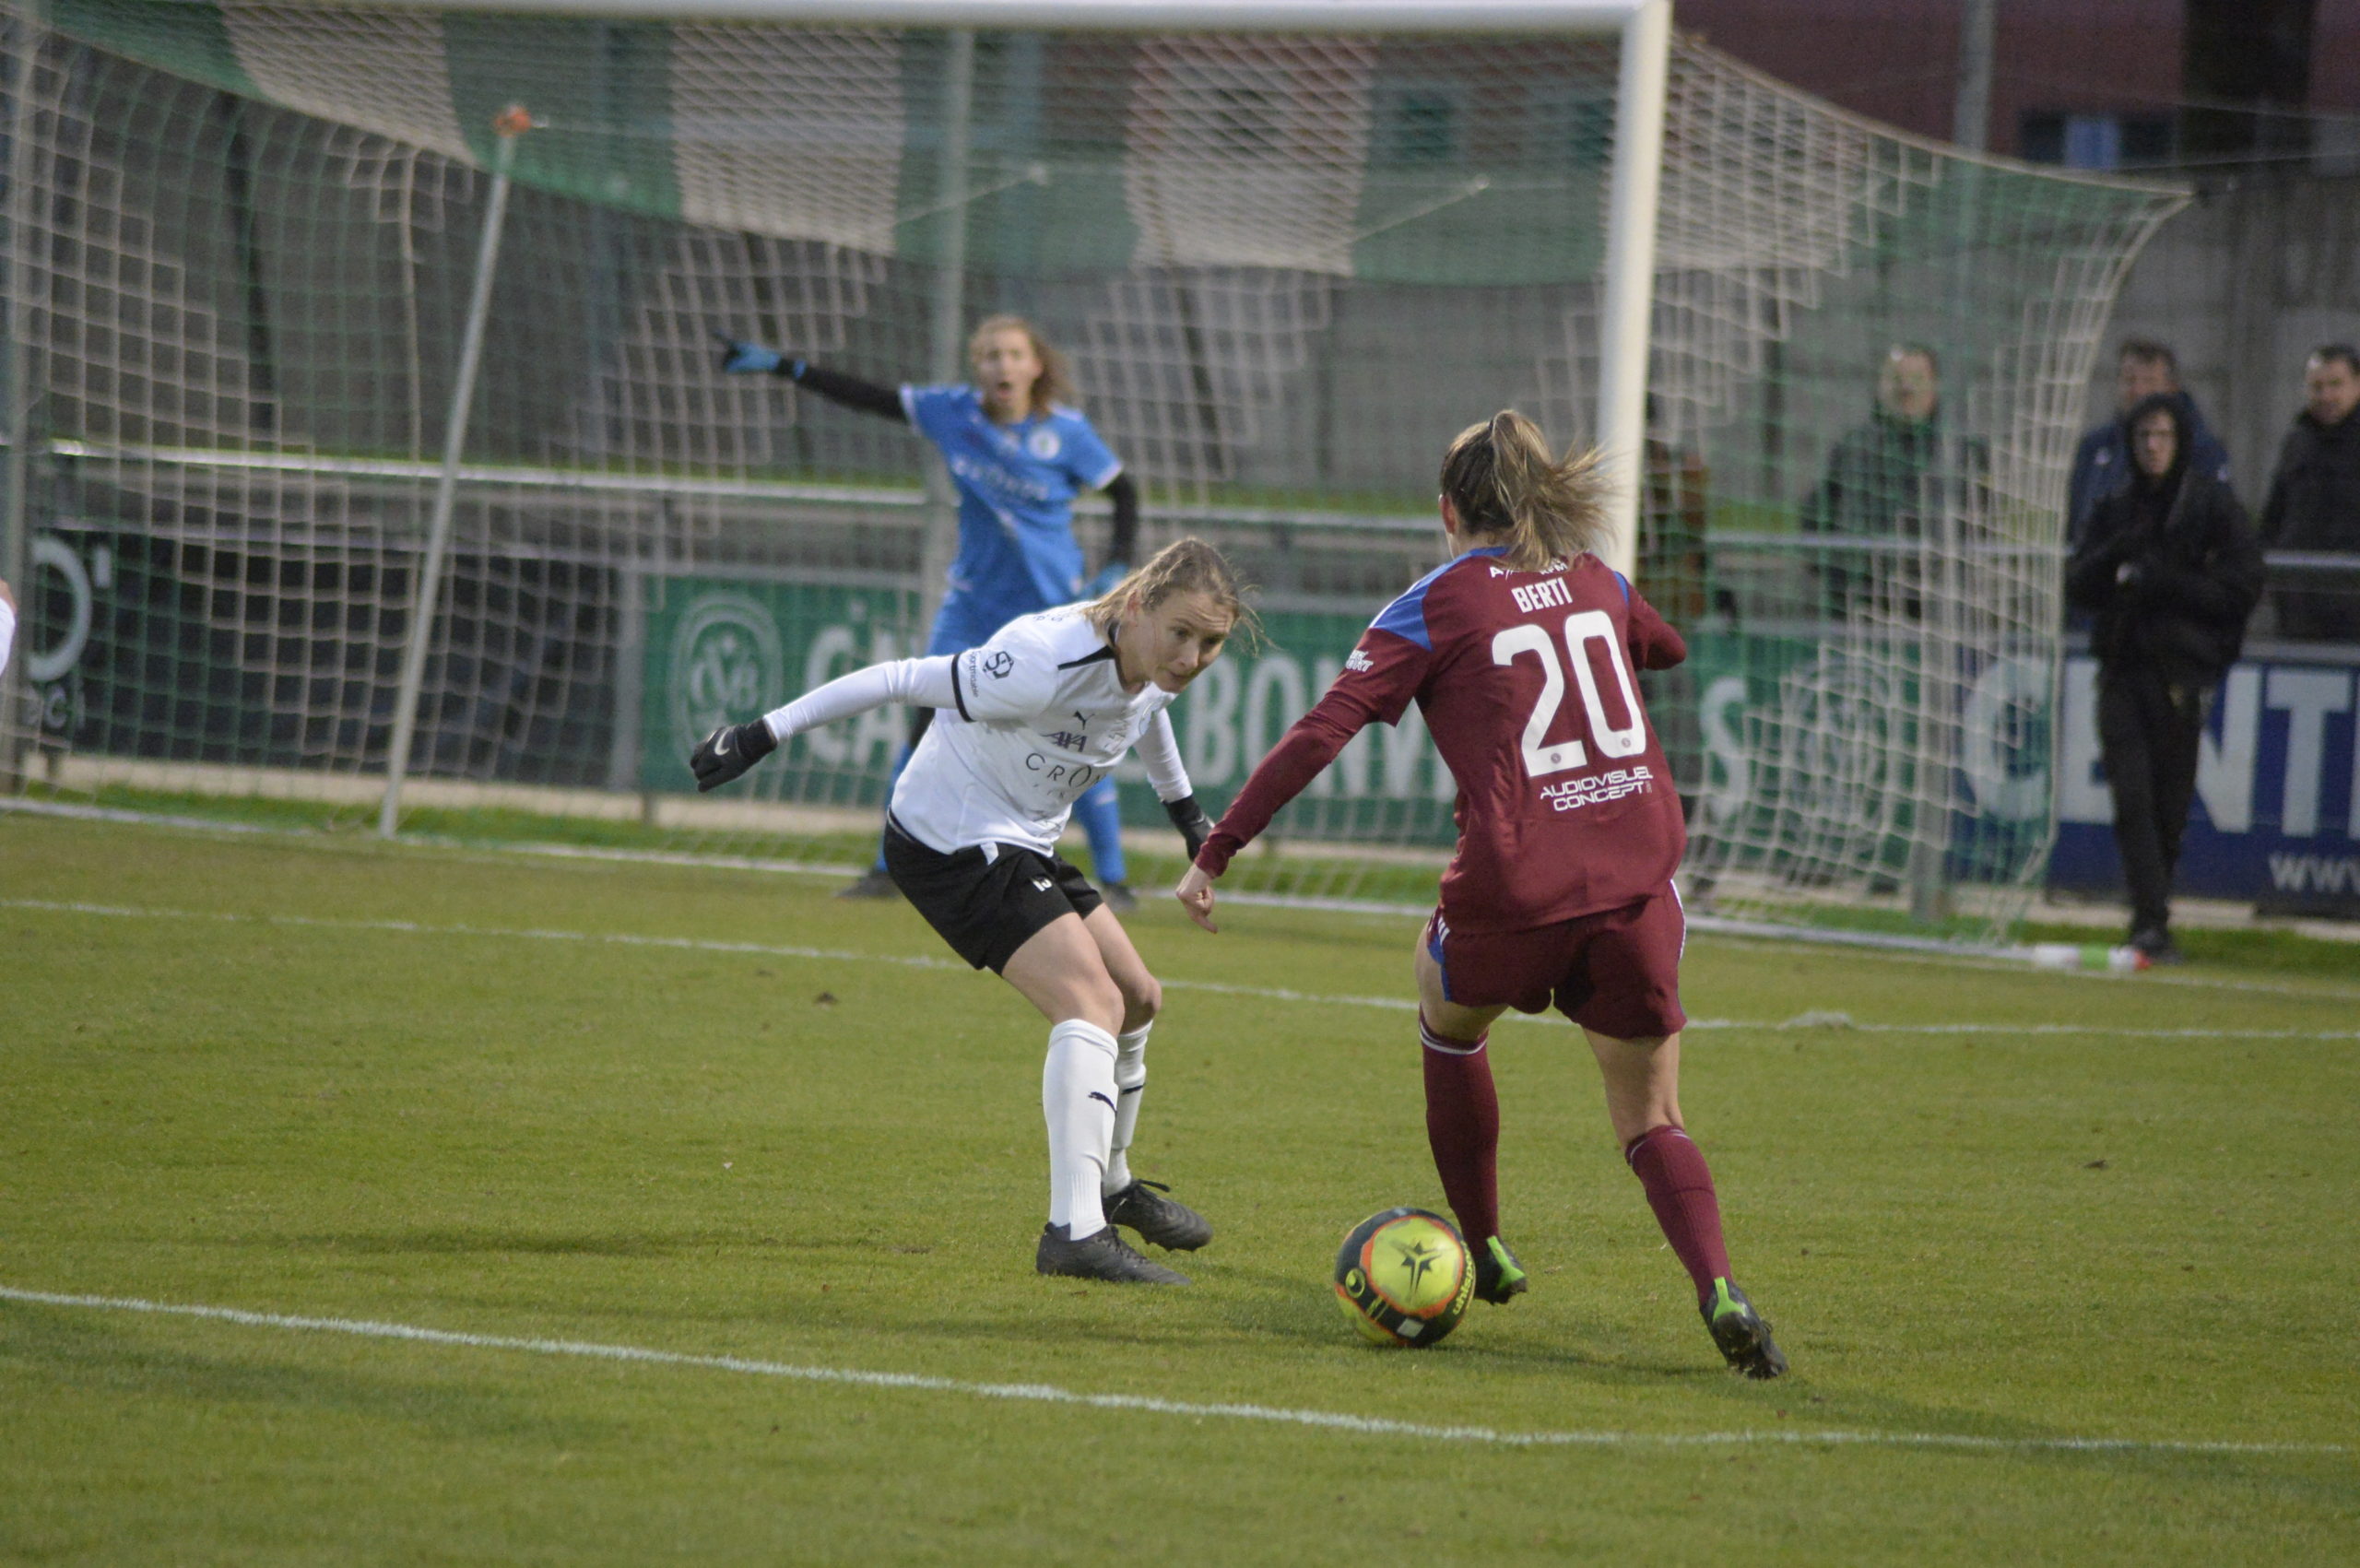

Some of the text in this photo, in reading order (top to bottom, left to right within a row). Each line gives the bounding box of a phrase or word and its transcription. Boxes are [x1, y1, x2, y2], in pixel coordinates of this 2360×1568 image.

[1511, 577, 1573, 613] BERTI
[1492, 609, 1646, 777] 20
[1552, 781, 1645, 811] CONCEPT
